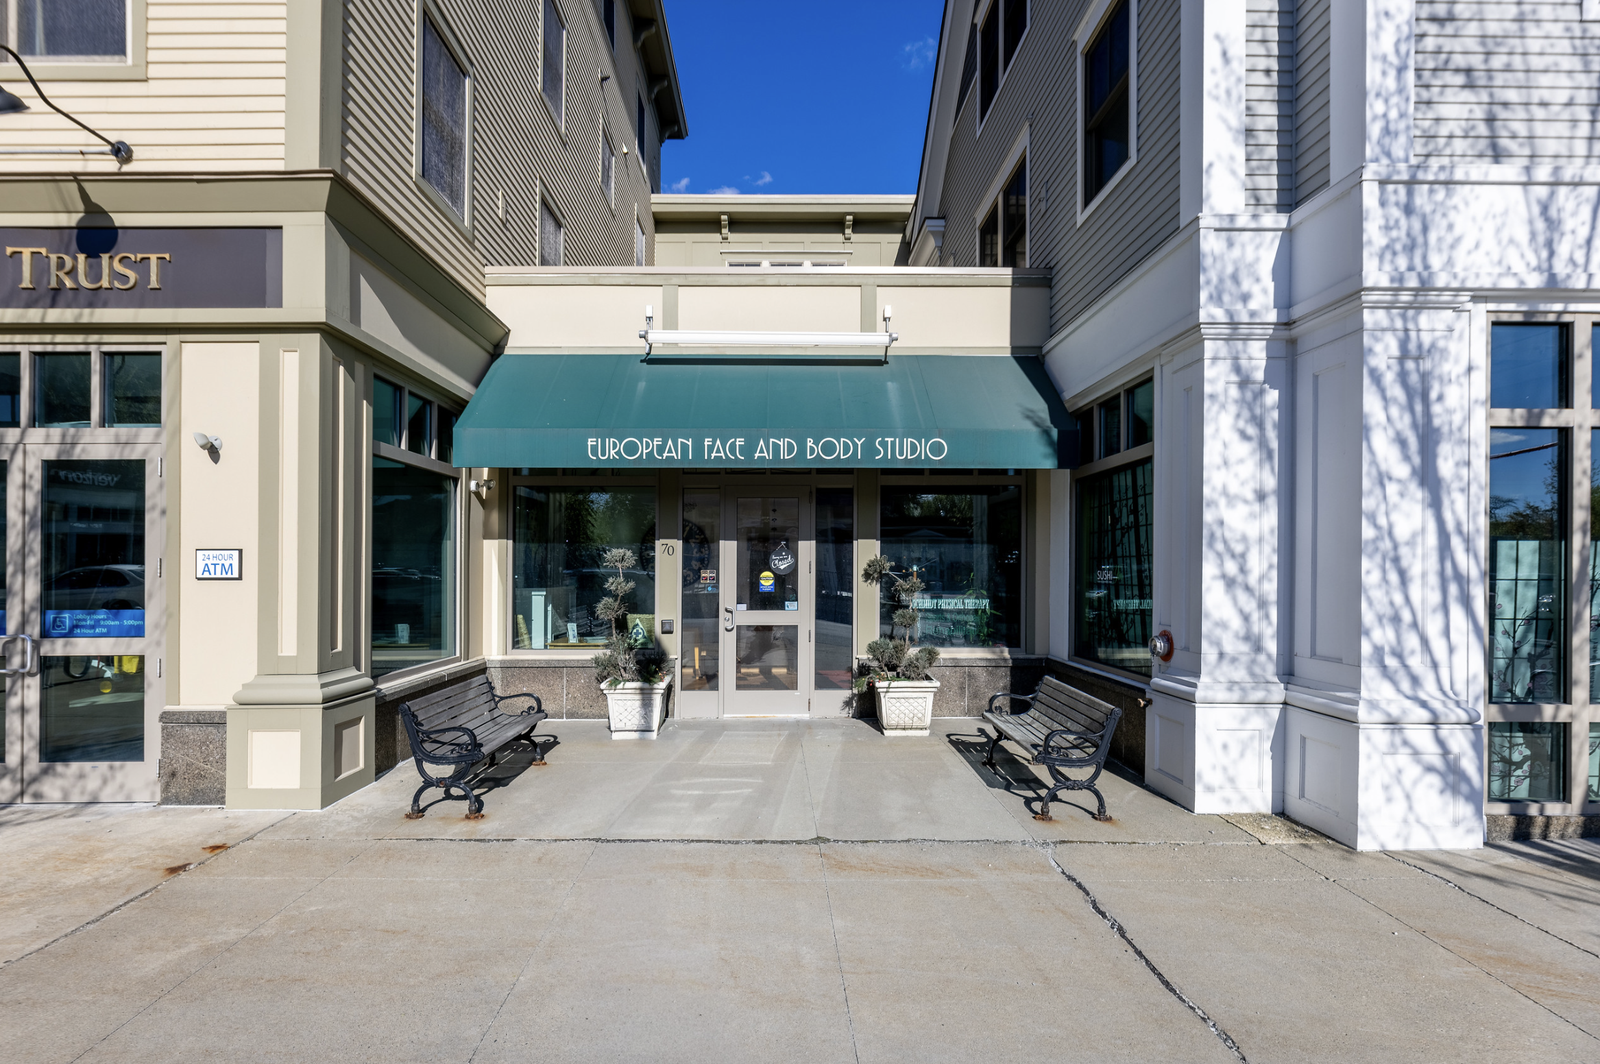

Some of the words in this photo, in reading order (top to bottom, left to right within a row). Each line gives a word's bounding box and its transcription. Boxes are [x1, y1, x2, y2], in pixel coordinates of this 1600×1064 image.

[5, 246, 172, 290] TRUST
[587, 437, 692, 460] EUROPEAN
[704, 437, 745, 460] FACE
[754, 437, 798, 460] AND
[806, 437, 866, 460] BODY
[875, 437, 948, 460] STUDIO
[661, 543, 675, 557] 70
[202, 553, 210, 561] 24
[212, 553, 234, 561] HOUR
[201, 563, 233, 576] ATM
[1097, 570, 1113, 580] SUSHI
[938, 599, 963, 609] PHYSICAL
[964, 599, 990, 609] THERAPY
